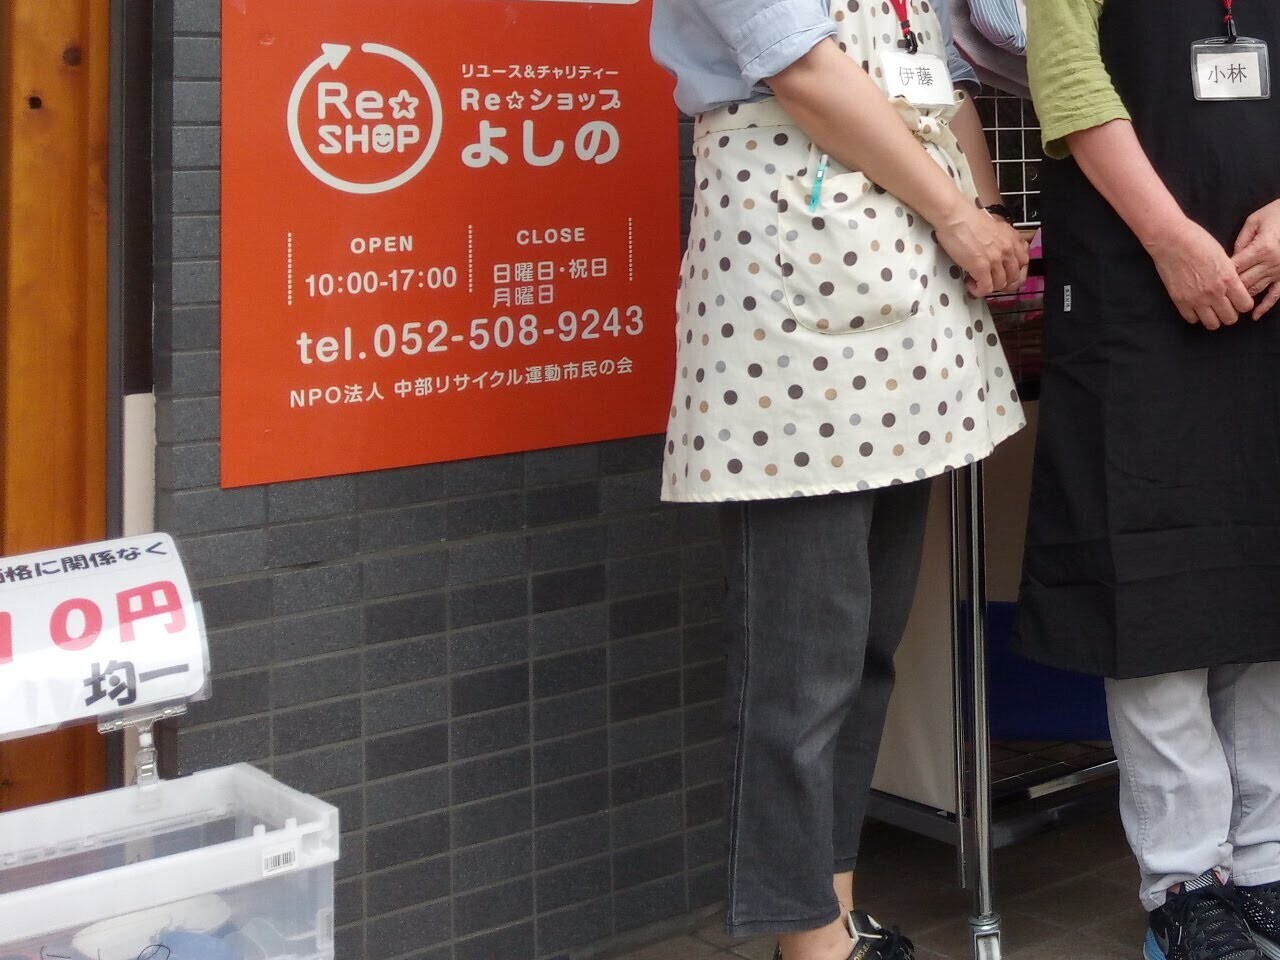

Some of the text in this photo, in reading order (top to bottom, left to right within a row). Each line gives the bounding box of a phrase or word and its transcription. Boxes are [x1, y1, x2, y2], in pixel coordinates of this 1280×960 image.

[461, 64, 619, 80] リユース&チャリティー
[899, 66, 933, 87] 伊藤
[1208, 63, 1248, 84] 小林
[317, 124, 420, 155] SHOP
[460, 119, 620, 167] よしの
[350, 235, 414, 254] OPEN
[516, 227, 586, 246] CLOSE
[305, 266, 457, 297] 10:00-17:00
[493, 257, 608, 284] 日曜日・祝日
[492, 285, 554, 308] 月曜日
[296, 305, 645, 365] tel.052-508-9243
[290, 357, 633, 408] NPO法人 中部リサイクル運動市民の会
[84, 658, 190, 707] 均一
